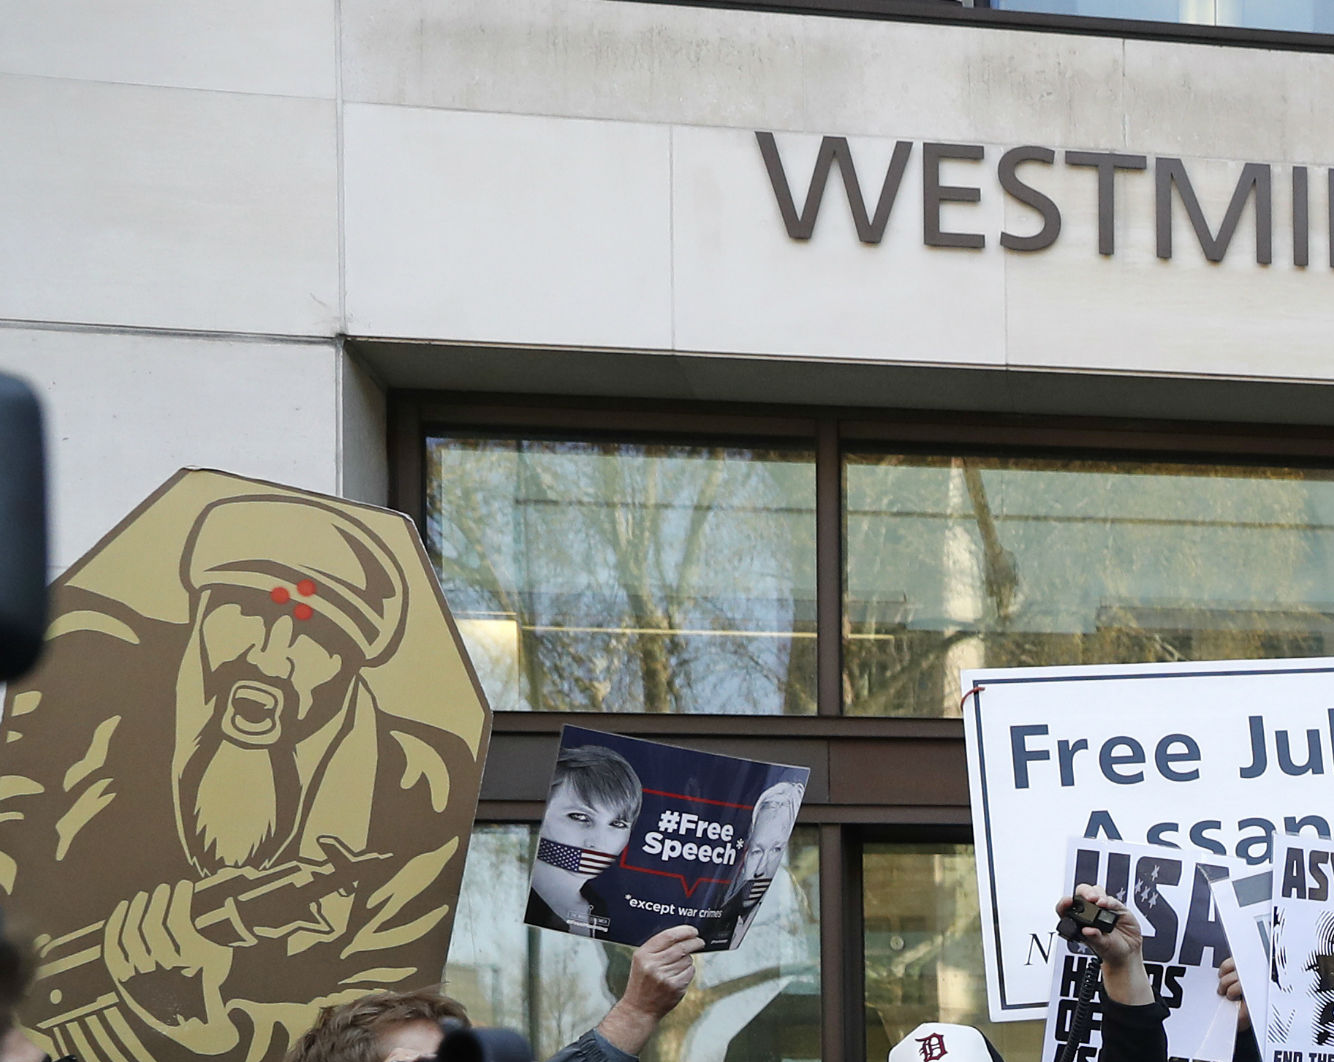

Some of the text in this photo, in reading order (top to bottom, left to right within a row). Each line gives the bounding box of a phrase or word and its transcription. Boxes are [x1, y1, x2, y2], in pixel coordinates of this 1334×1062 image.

[1009, 724, 1202, 789] Free
[658, 810, 734, 842] #Free
[678, 906, 697, 917] war
[699, 908, 723, 918] crimes
